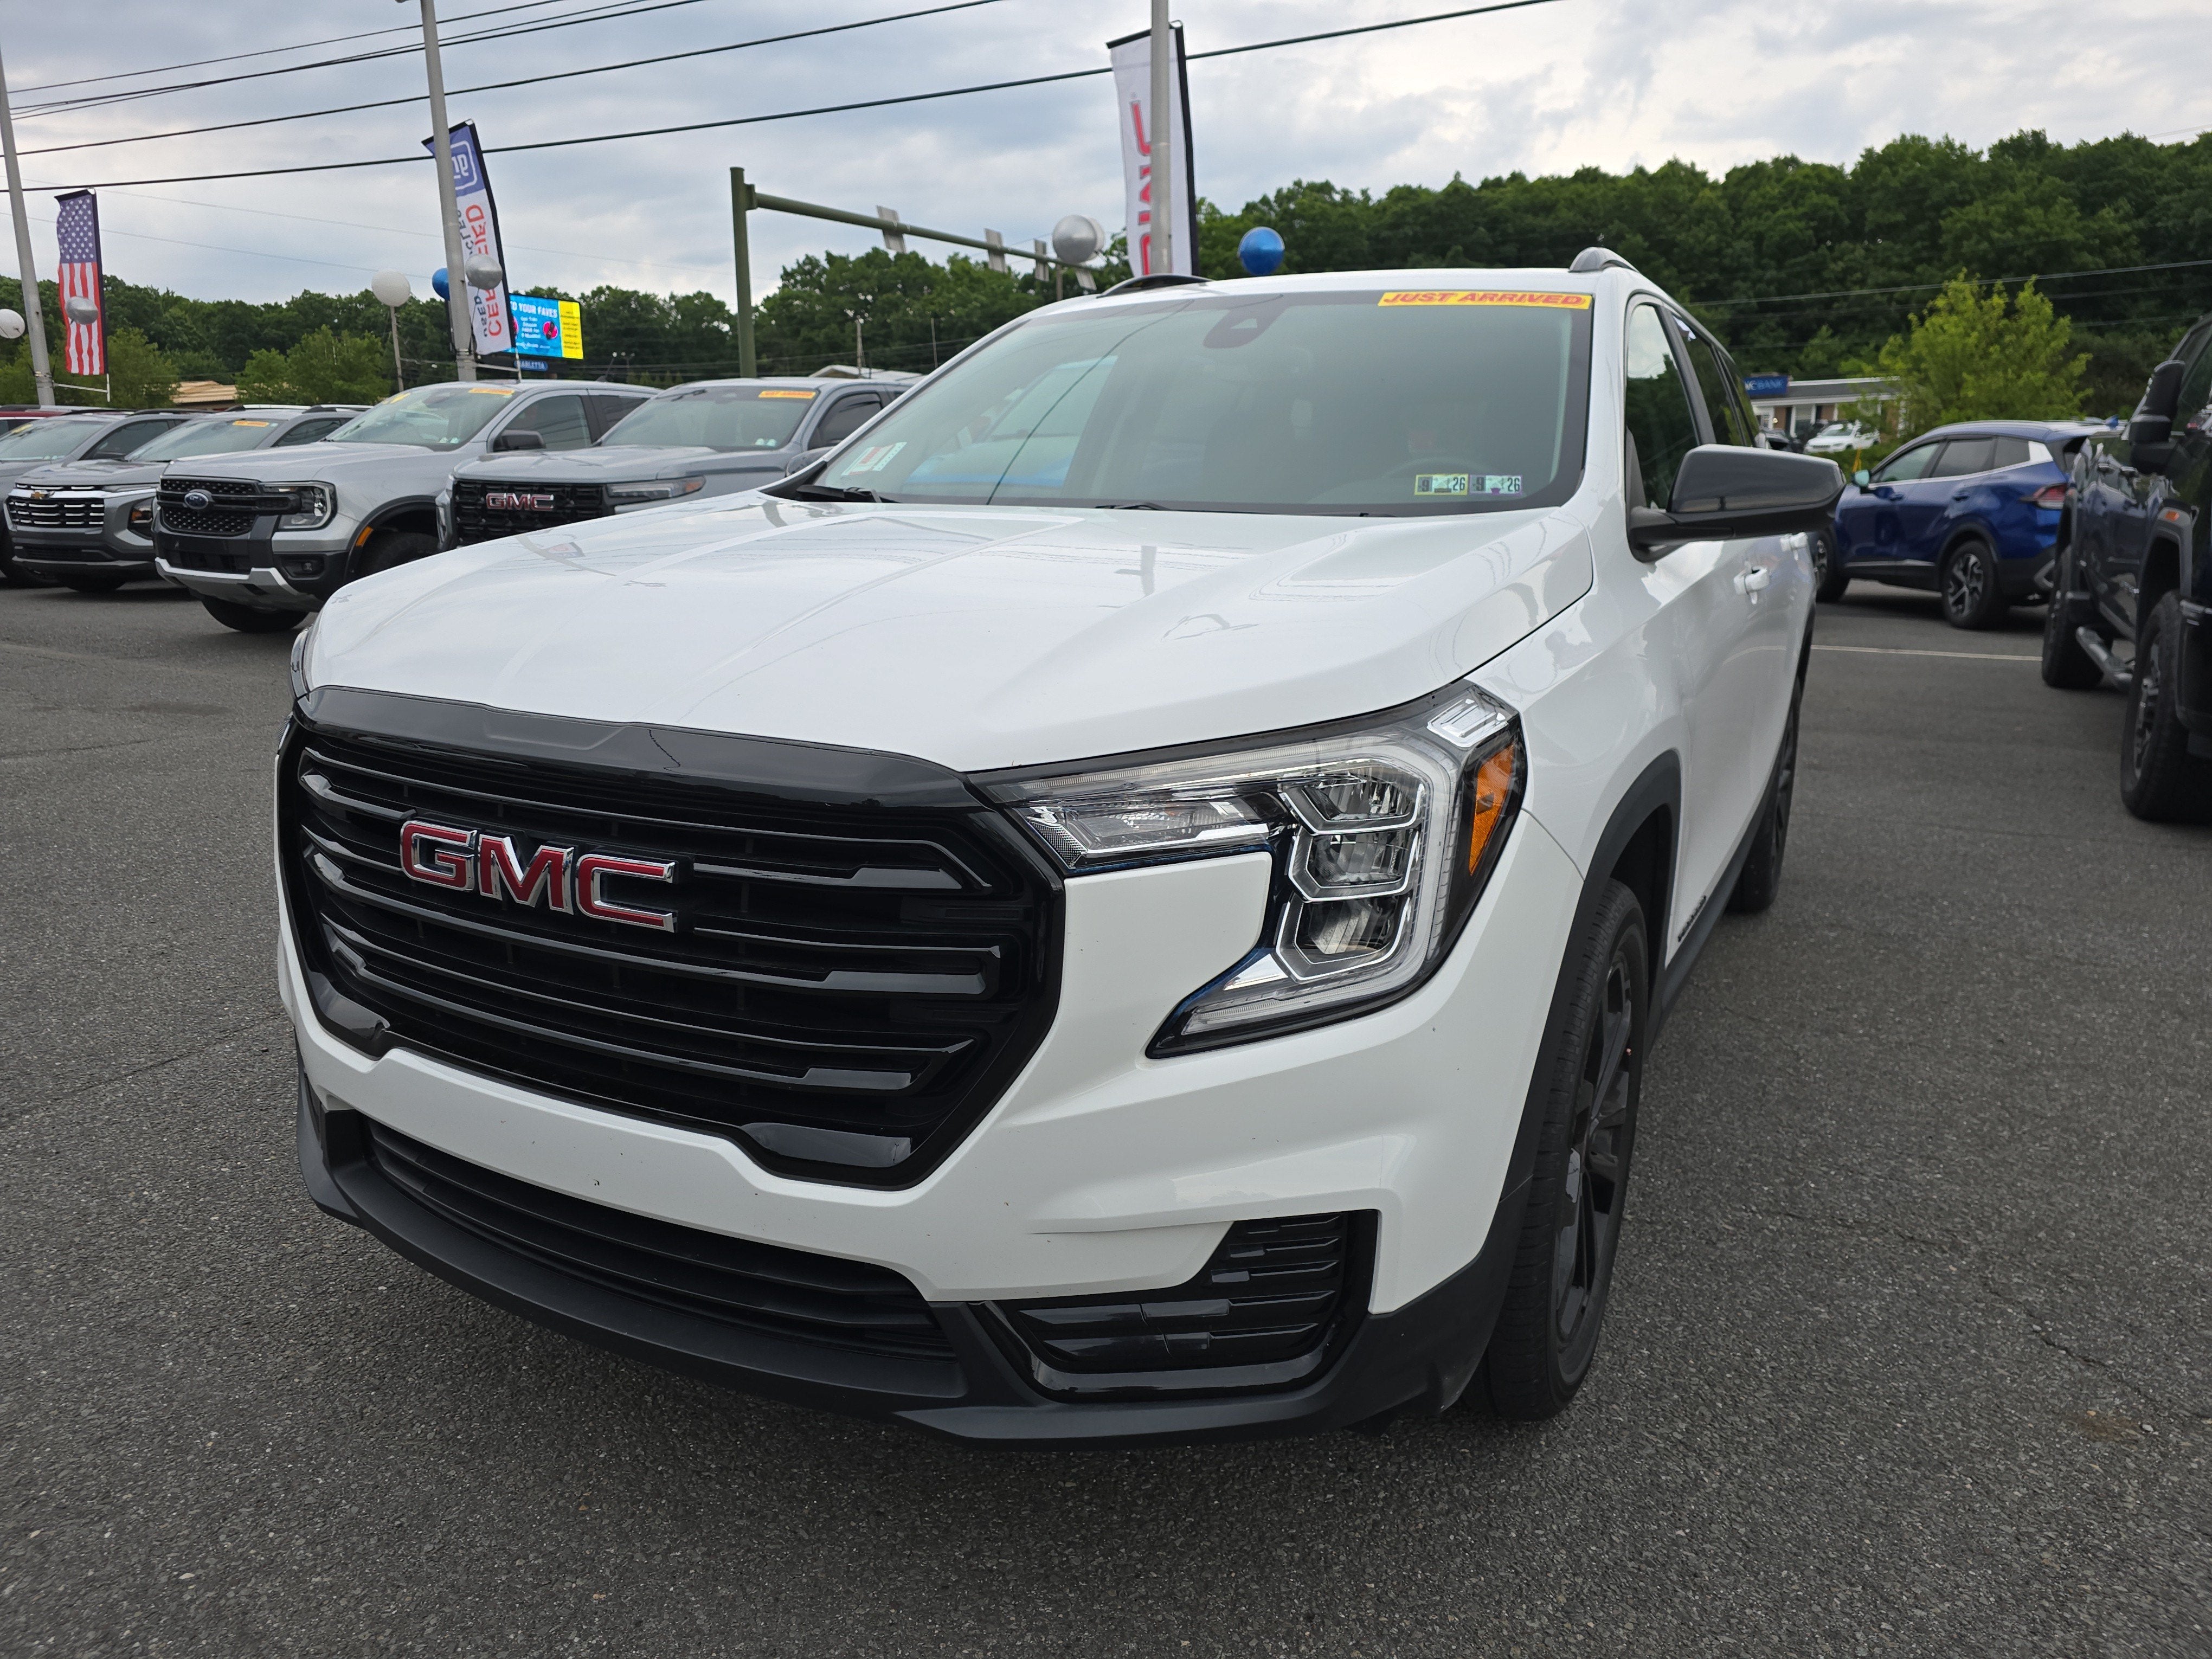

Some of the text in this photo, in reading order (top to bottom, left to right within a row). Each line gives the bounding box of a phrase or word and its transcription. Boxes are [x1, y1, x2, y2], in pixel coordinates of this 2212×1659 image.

[1383, 292, 1585, 305] JUST ARRIVED
[1453, 477, 1465, 492] 26
[1507, 477, 1520, 492] 26
[486, 492, 554, 511] GMC
[400, 820, 676, 934] GMC
